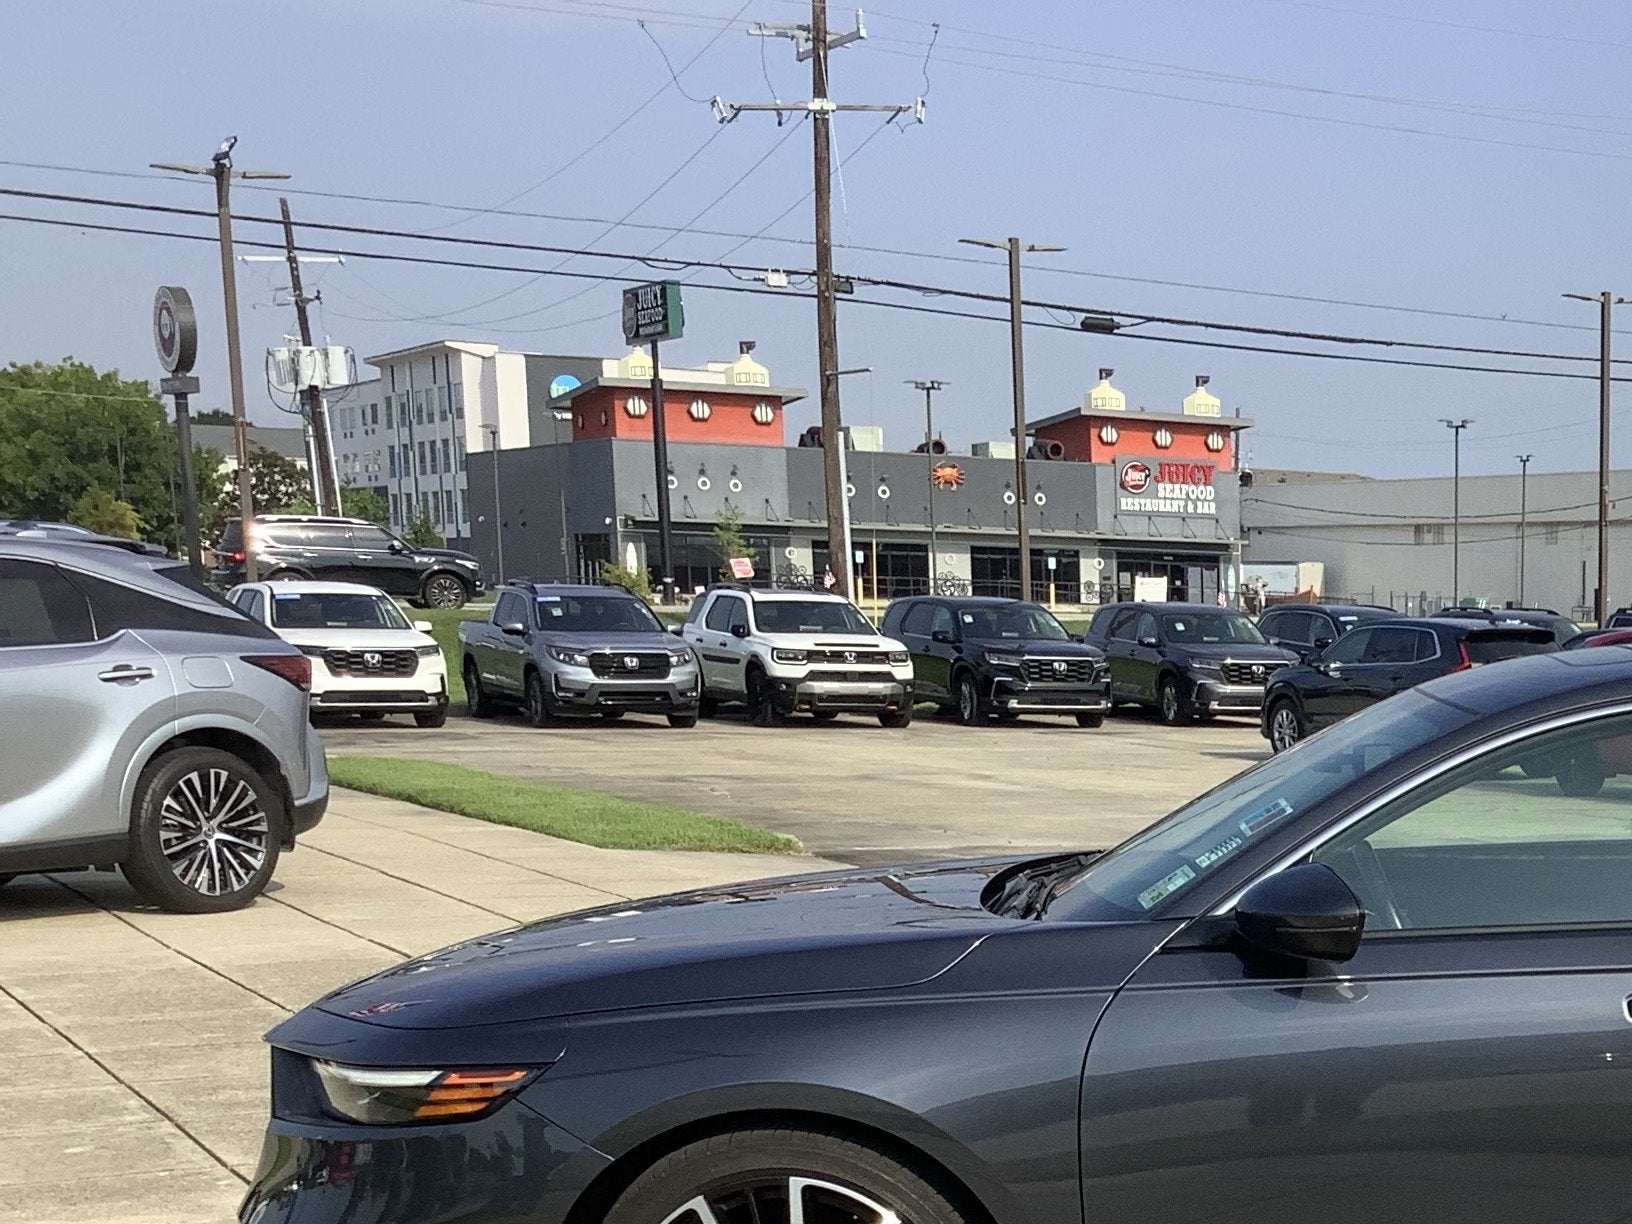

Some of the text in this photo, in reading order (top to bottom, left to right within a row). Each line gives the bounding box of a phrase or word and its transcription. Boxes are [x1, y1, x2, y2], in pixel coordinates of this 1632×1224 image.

[636, 285, 662, 310] JUICY
[1154, 463, 1215, 486] JUICY
[1157, 483, 1215, 501] SEAFOOD
[1120, 498, 1217, 515] RESTAURANT & BAR
